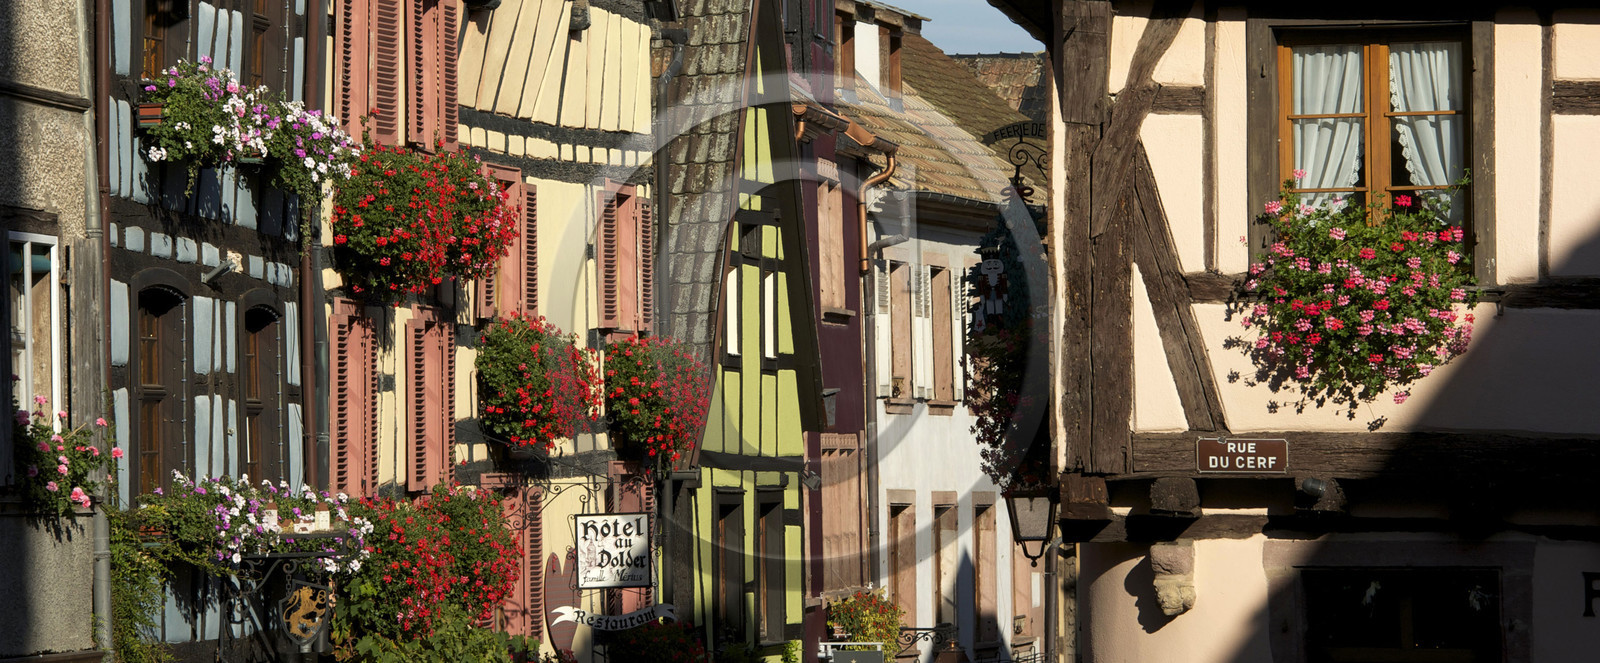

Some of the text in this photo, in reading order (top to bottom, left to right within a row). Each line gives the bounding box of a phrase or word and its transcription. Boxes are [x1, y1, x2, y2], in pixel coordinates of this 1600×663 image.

[1227, 442, 1256, 453] RUE
[1208, 456, 1277, 469] DU CERF
[581, 517, 644, 541] Hôtel
[615, 538, 633, 549] au
[597, 549, 646, 568] Dolder
[573, 610, 656, 630] Restaurant
